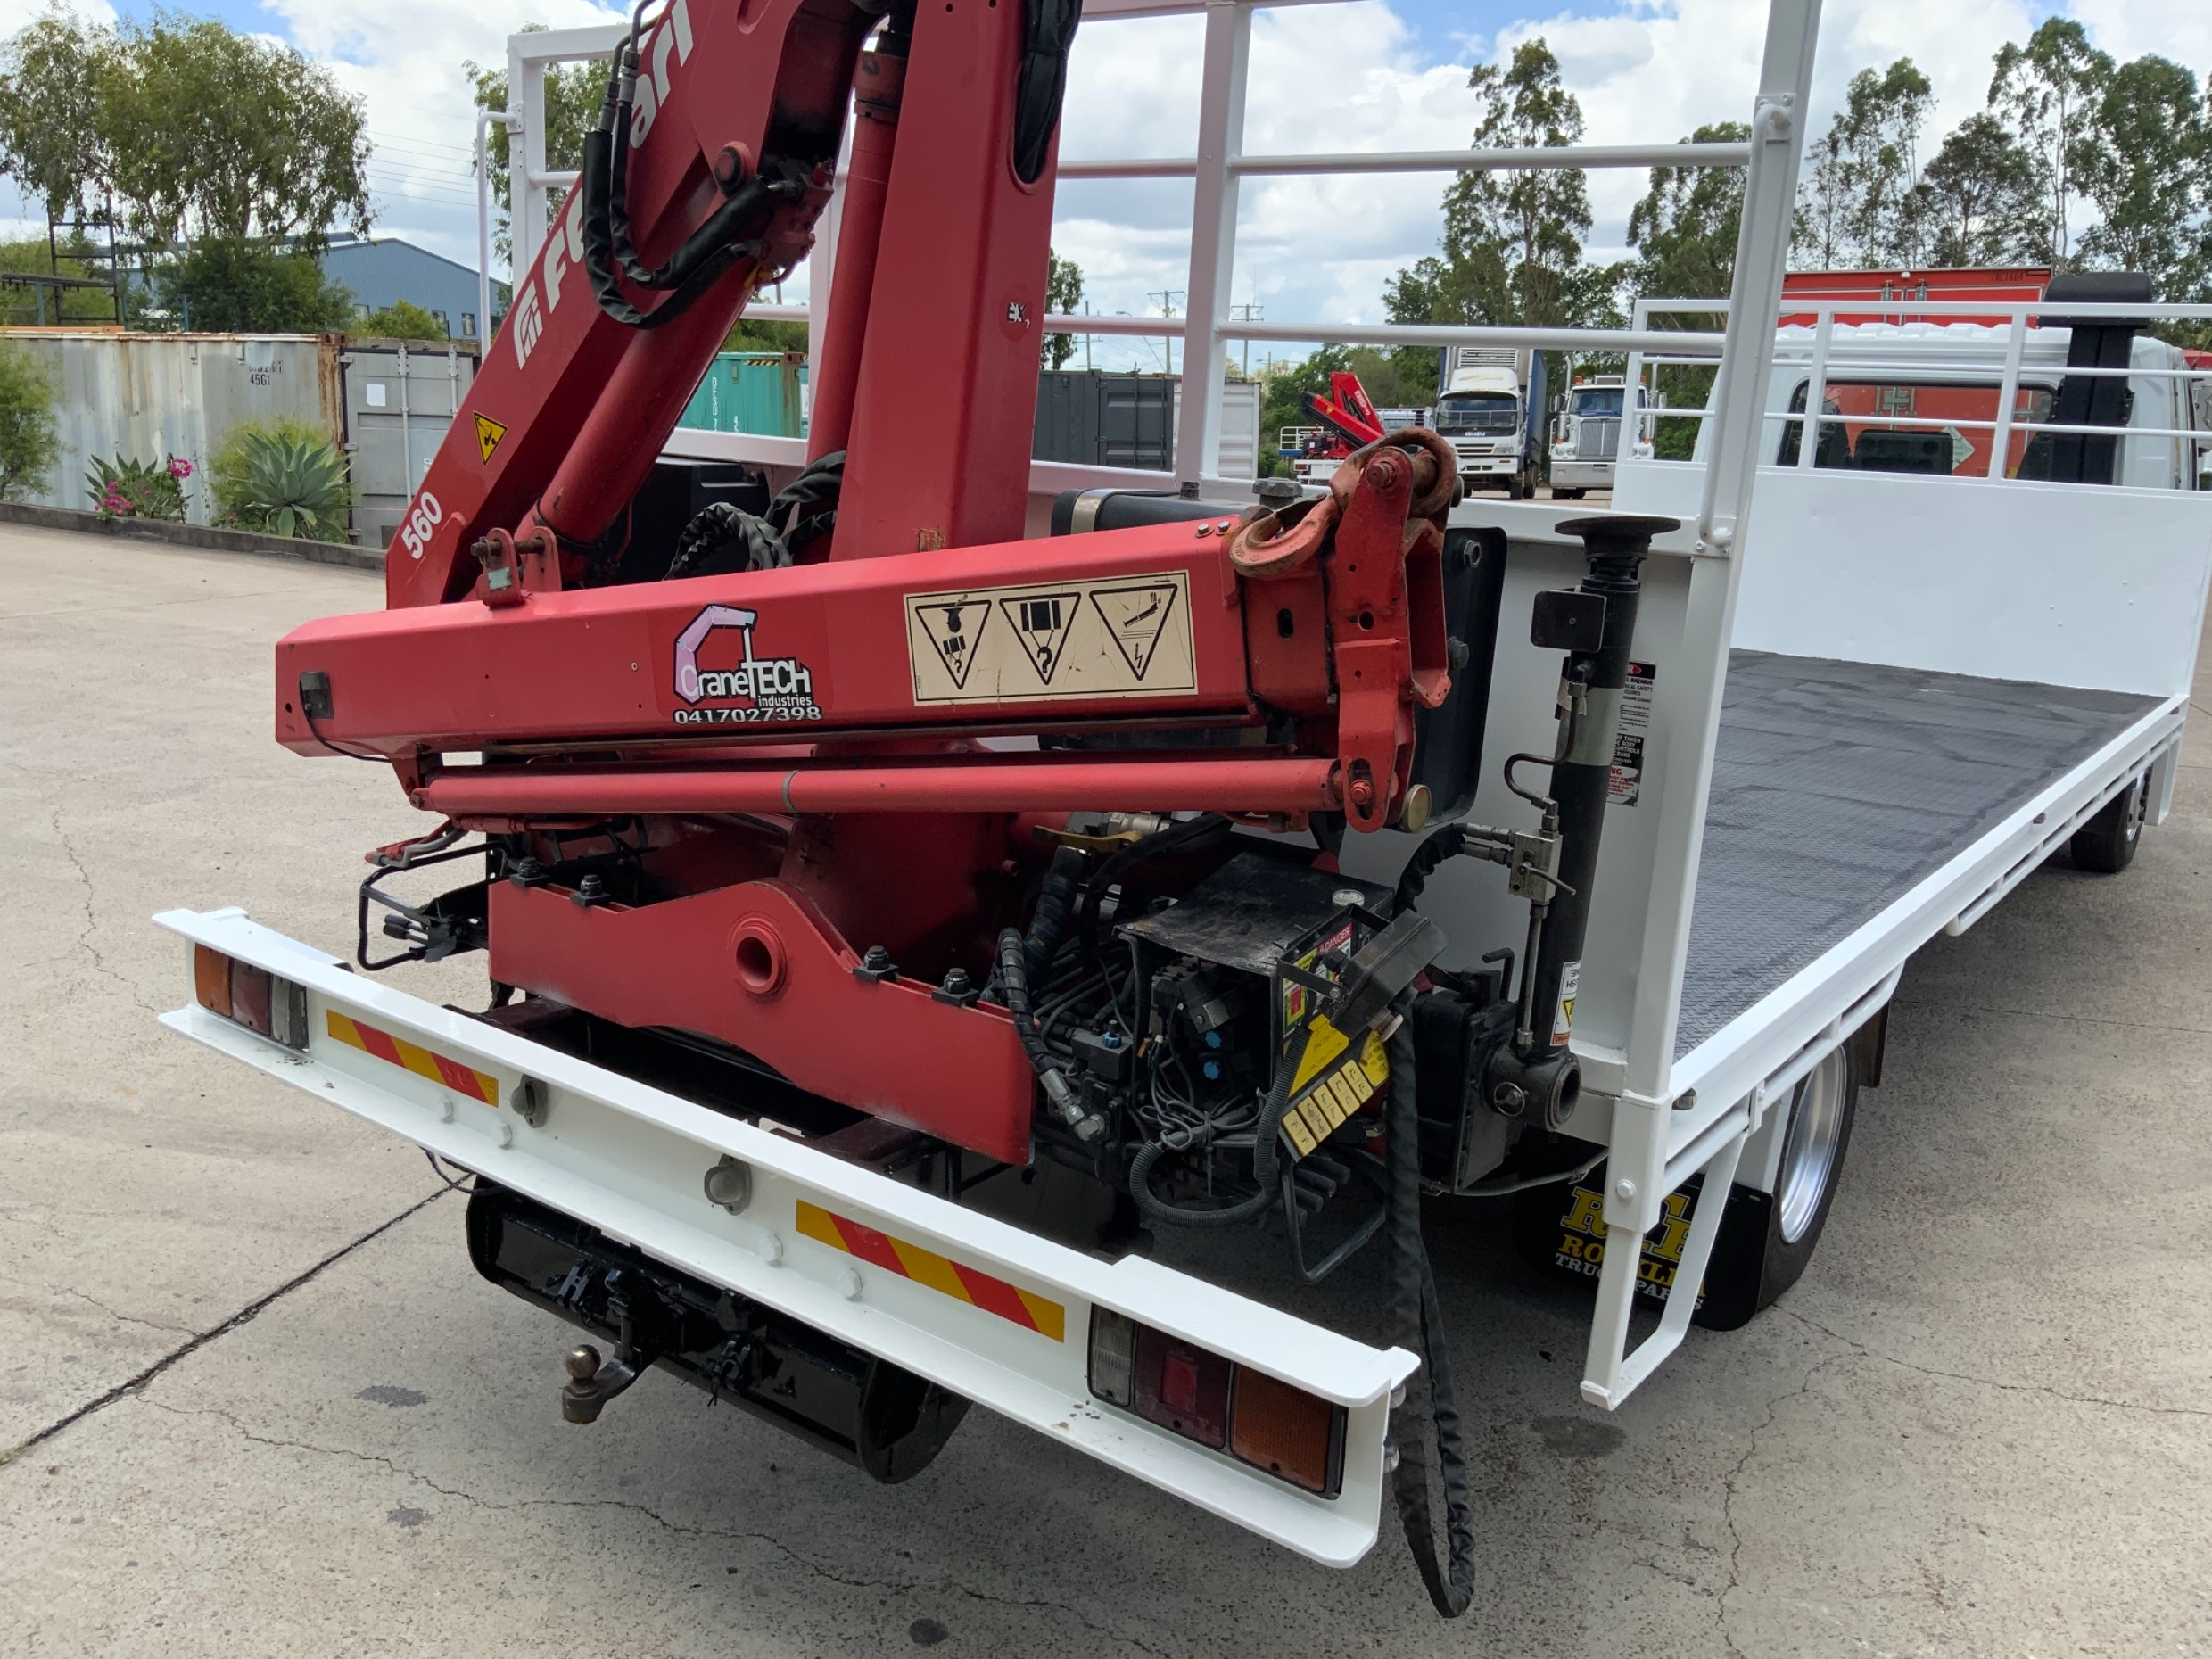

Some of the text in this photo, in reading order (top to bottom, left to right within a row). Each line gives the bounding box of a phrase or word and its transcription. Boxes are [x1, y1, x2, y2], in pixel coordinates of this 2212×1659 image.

[543, 0, 694, 315] Feari
[400, 491, 442, 559] 560
[674, 706, 822, 724] 0417027398
[758, 694, 813, 707] industries
